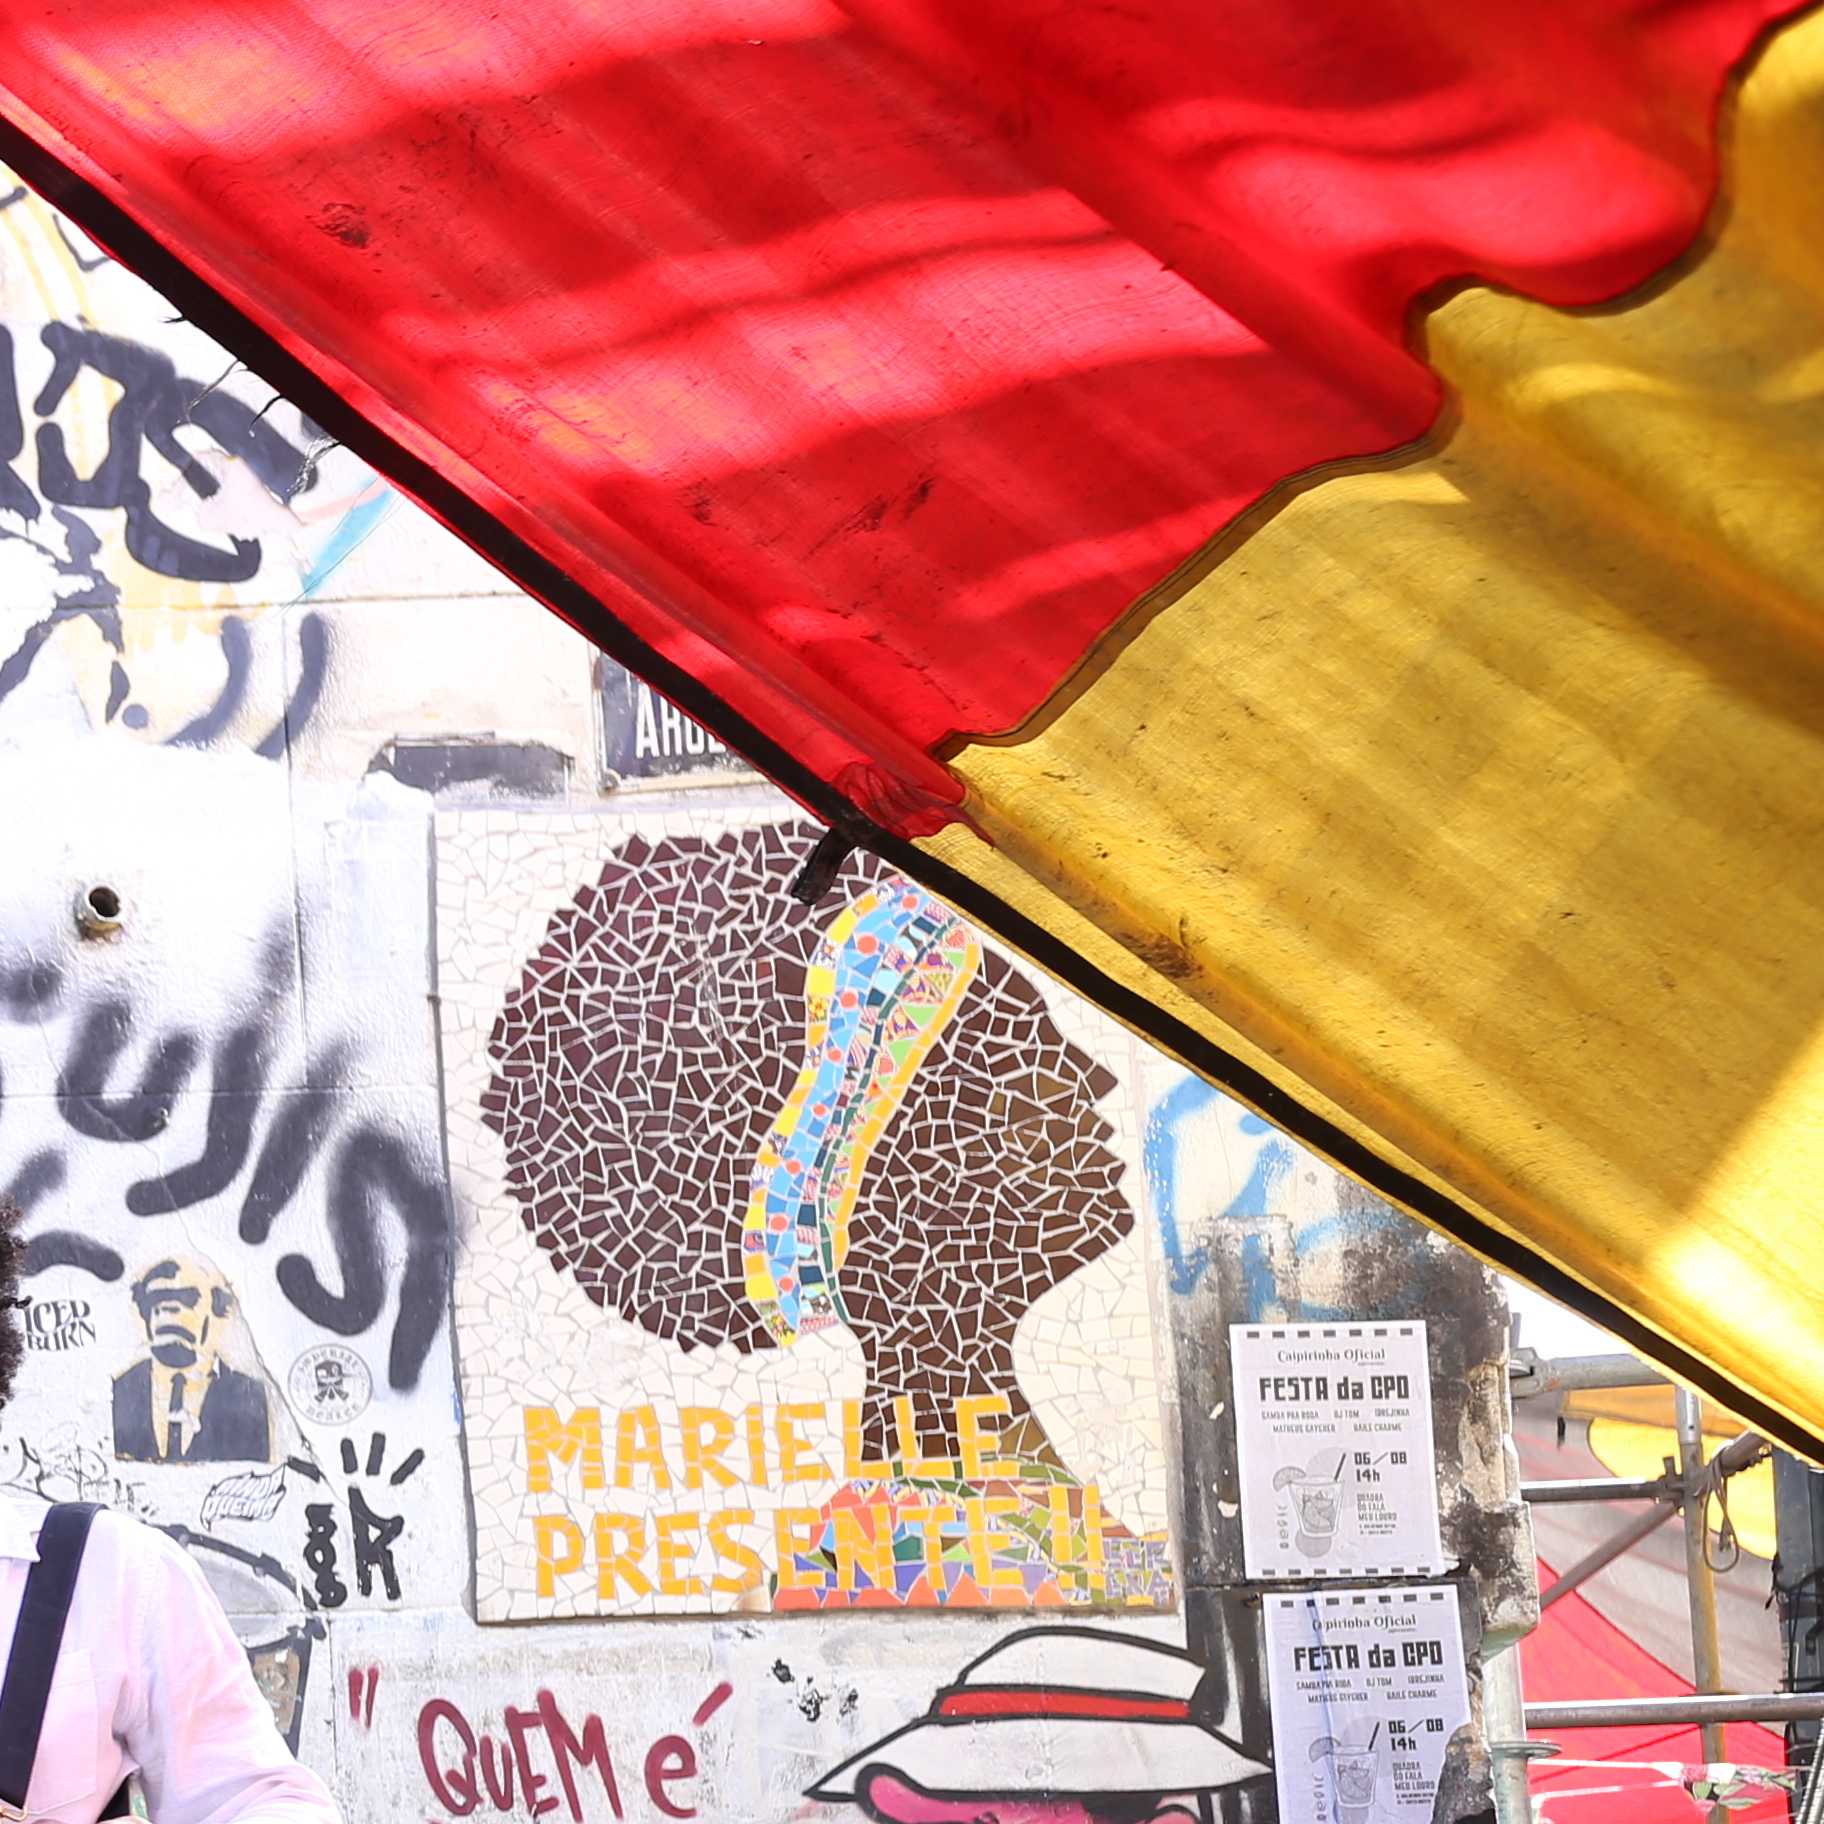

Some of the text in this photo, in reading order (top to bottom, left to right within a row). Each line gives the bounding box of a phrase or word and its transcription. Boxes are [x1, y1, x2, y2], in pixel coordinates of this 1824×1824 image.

[1259, 1375, 1410, 1401] FESTA da CPO
[523, 1394, 1022, 1492] MARIELLE
[1356, 1469, 1380, 1482] 14h
[1368, 1643, 1396, 1668] da
[1402, 1640, 1443, 1666] CPO
[1390, 1737, 1416, 1751] 14h
